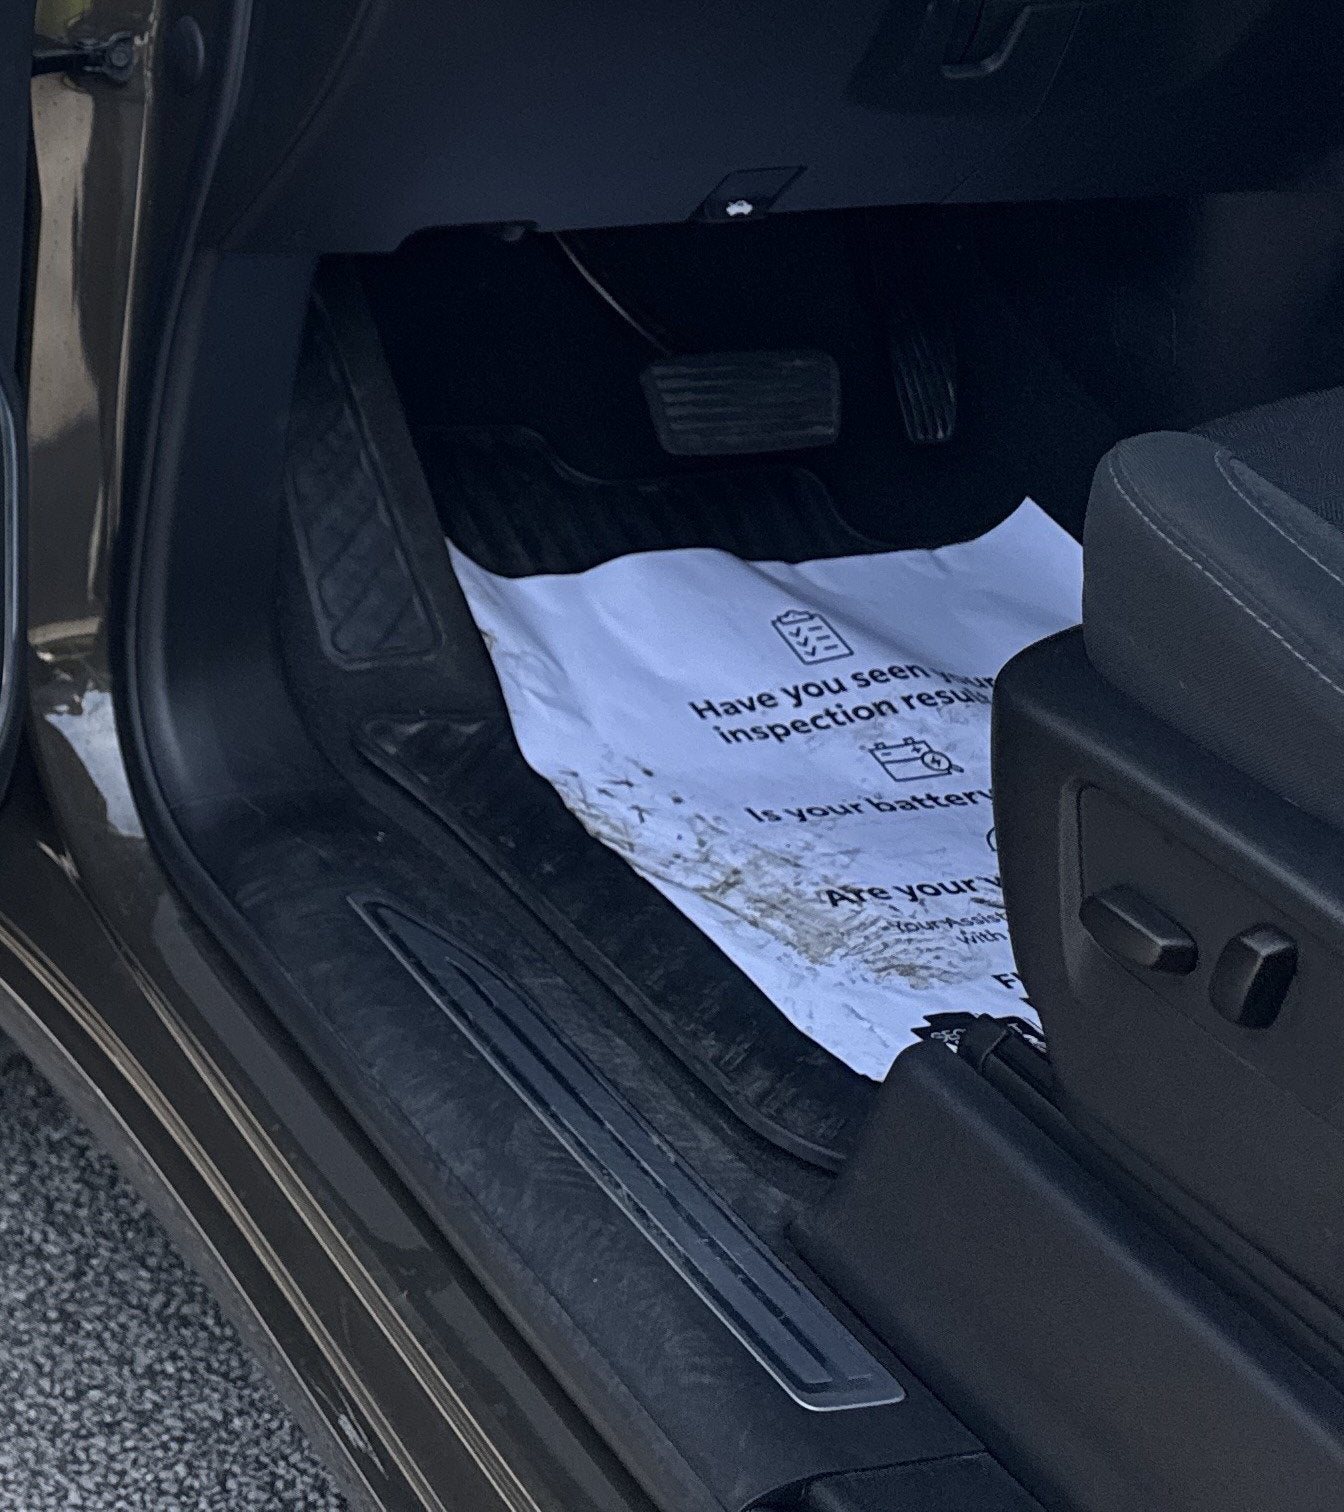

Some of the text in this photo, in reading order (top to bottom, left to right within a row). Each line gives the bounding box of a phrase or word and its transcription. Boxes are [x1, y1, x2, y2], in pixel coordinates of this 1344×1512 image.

[689, 690, 778, 720] Have
[780, 676, 848, 708] you
[850, 663, 930, 689] seen
[713, 702, 899, 744] inspection
[744, 805, 782, 823] Is
[782, 802, 864, 823] your
[825, 886, 892, 907] Are
[892, 878, 977, 902] your
